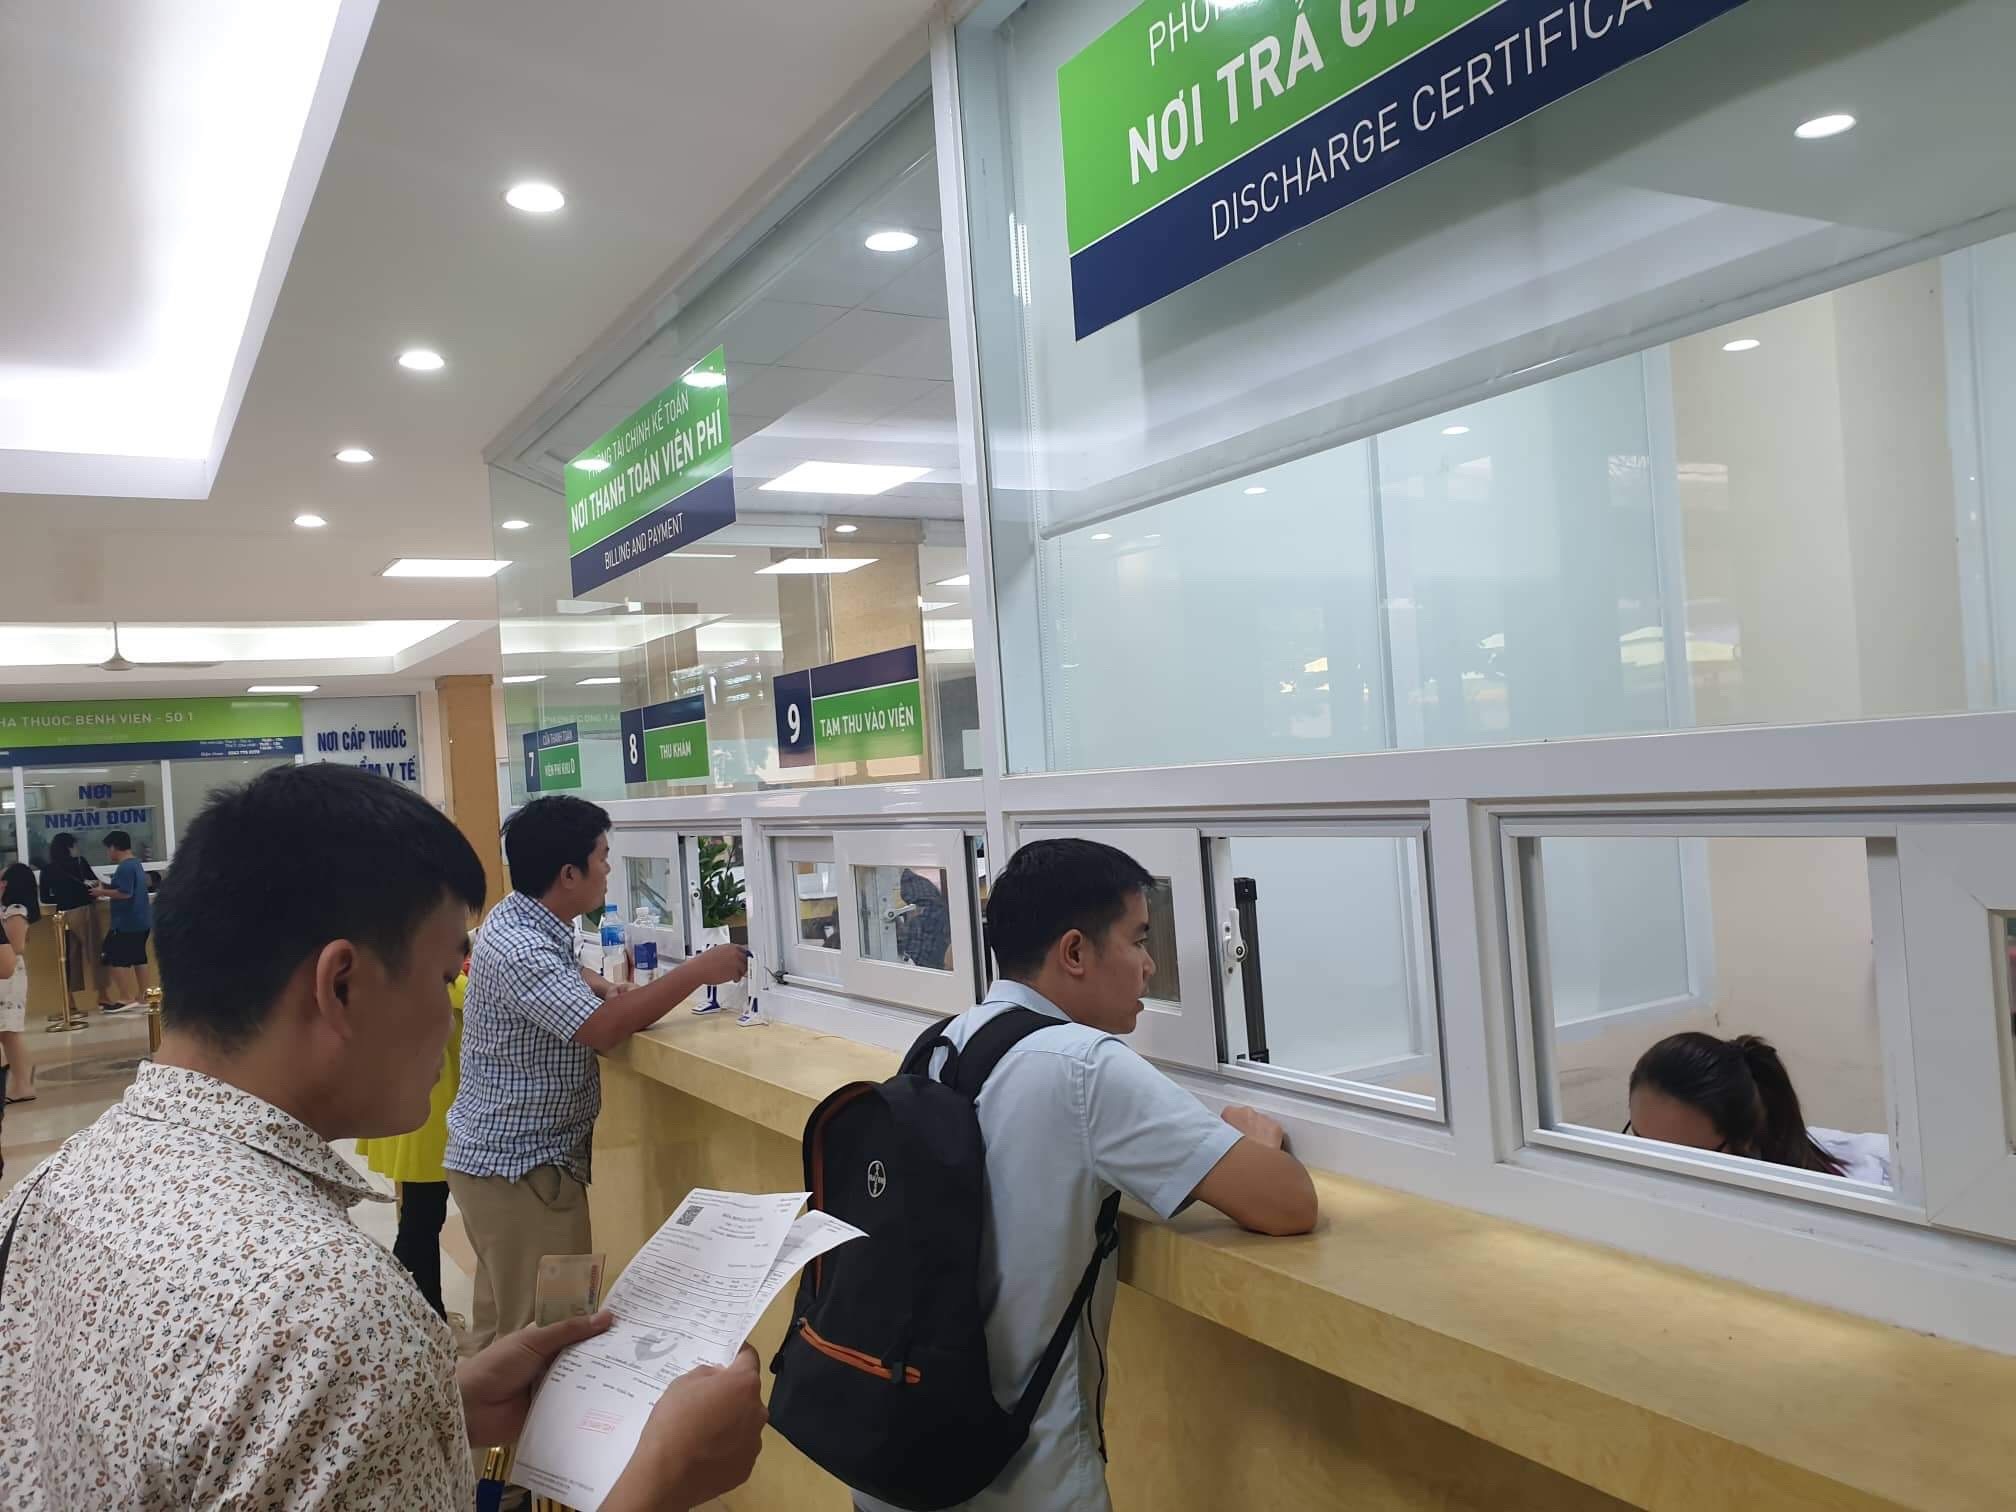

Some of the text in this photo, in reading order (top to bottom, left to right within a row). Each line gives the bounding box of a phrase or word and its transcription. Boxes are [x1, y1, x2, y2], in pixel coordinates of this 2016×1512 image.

[1128, 83, 1204, 185] NƠI
[1211, 102, 1401, 241] DISCHARGE
[625, 416, 650, 453] CHÍNH
[589, 473, 626, 521] THANH
[627, 448, 660, 497] TOÁN
[661, 427, 694, 476] VIỆN
[696, 398, 723, 456] PHÍ
[604, 512, 684, 570] BILLING AND PAYMENT
[342, 723, 365, 750] CẤP
[369, 722, 407, 749] THUỐC
[787, 703, 800, 744] 9
[820, 702, 915, 741] TẠM THU VÀO VIỆN
[528, 752, 535, 777] 7
[629, 733, 638, 765] 8
[659, 738, 692, 759] THU KHÁM
[386, 763, 395, 778] Y
[399, 755, 417, 781] TẾ
